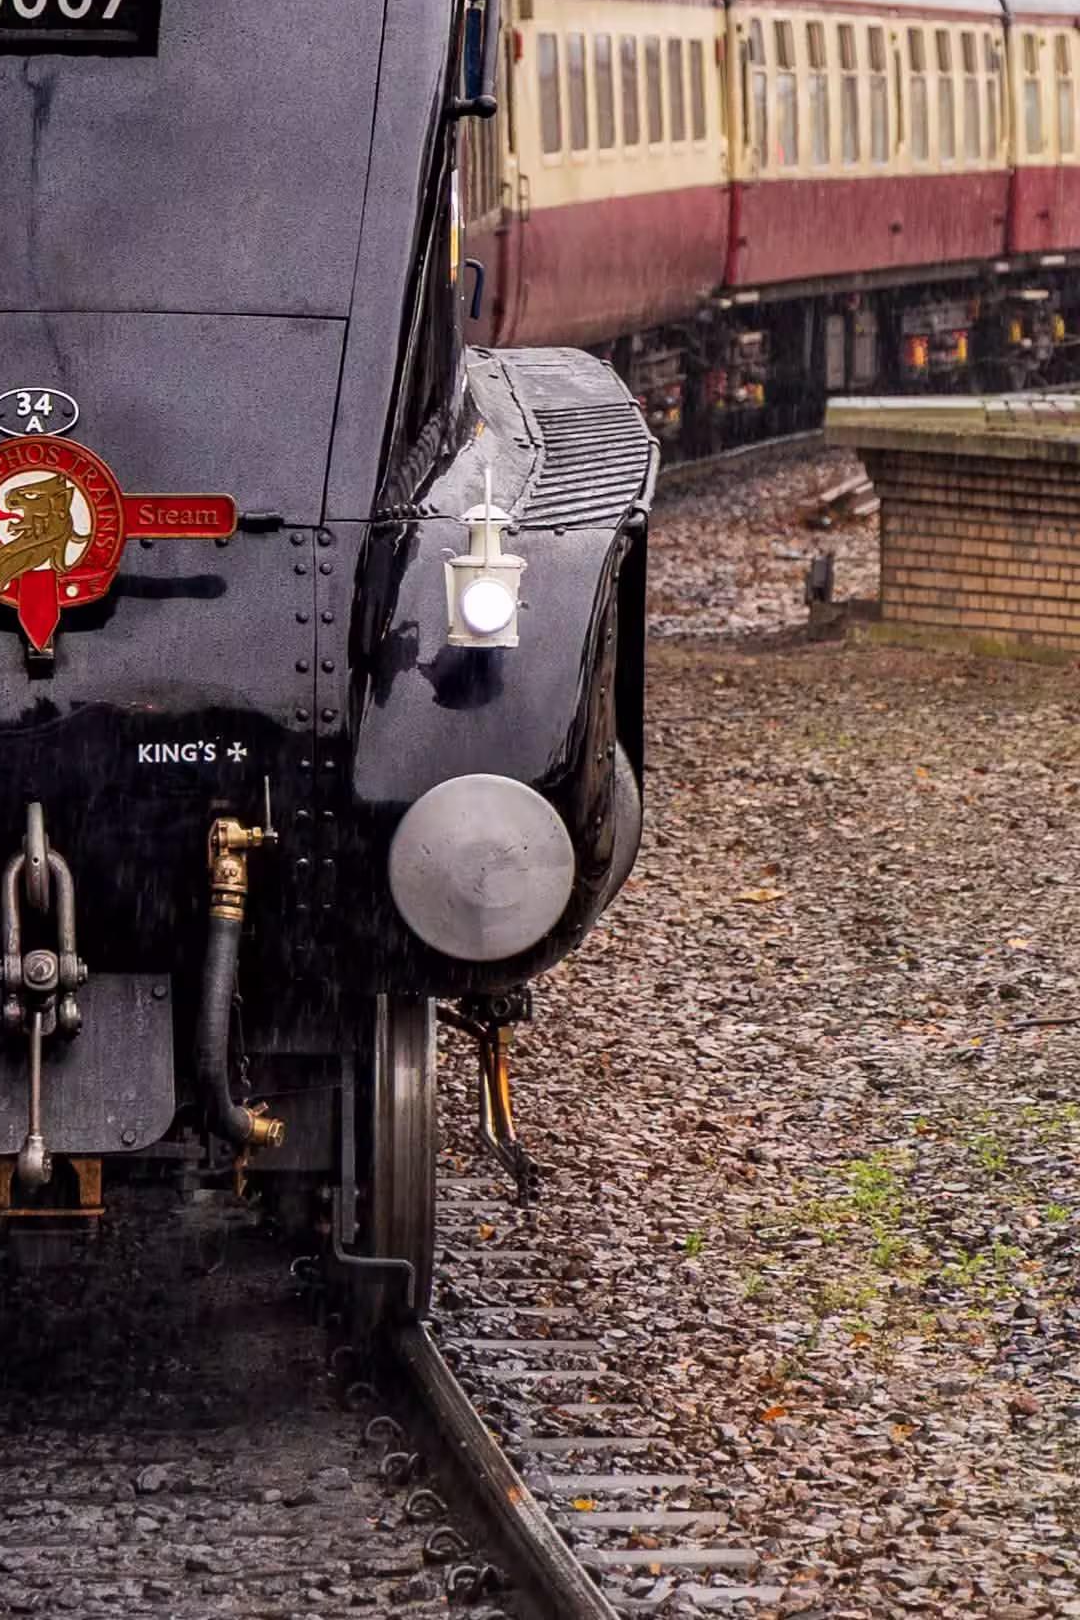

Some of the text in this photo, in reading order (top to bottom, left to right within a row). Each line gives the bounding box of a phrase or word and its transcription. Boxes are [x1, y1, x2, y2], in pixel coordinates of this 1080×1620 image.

[16, 392, 53, 416] 34
[25, 416, 44, 433] A
[70, 451, 116, 550] TRAINS
[138, 504, 220, 526] Steam
[137, 741, 218, 763] KING'S
